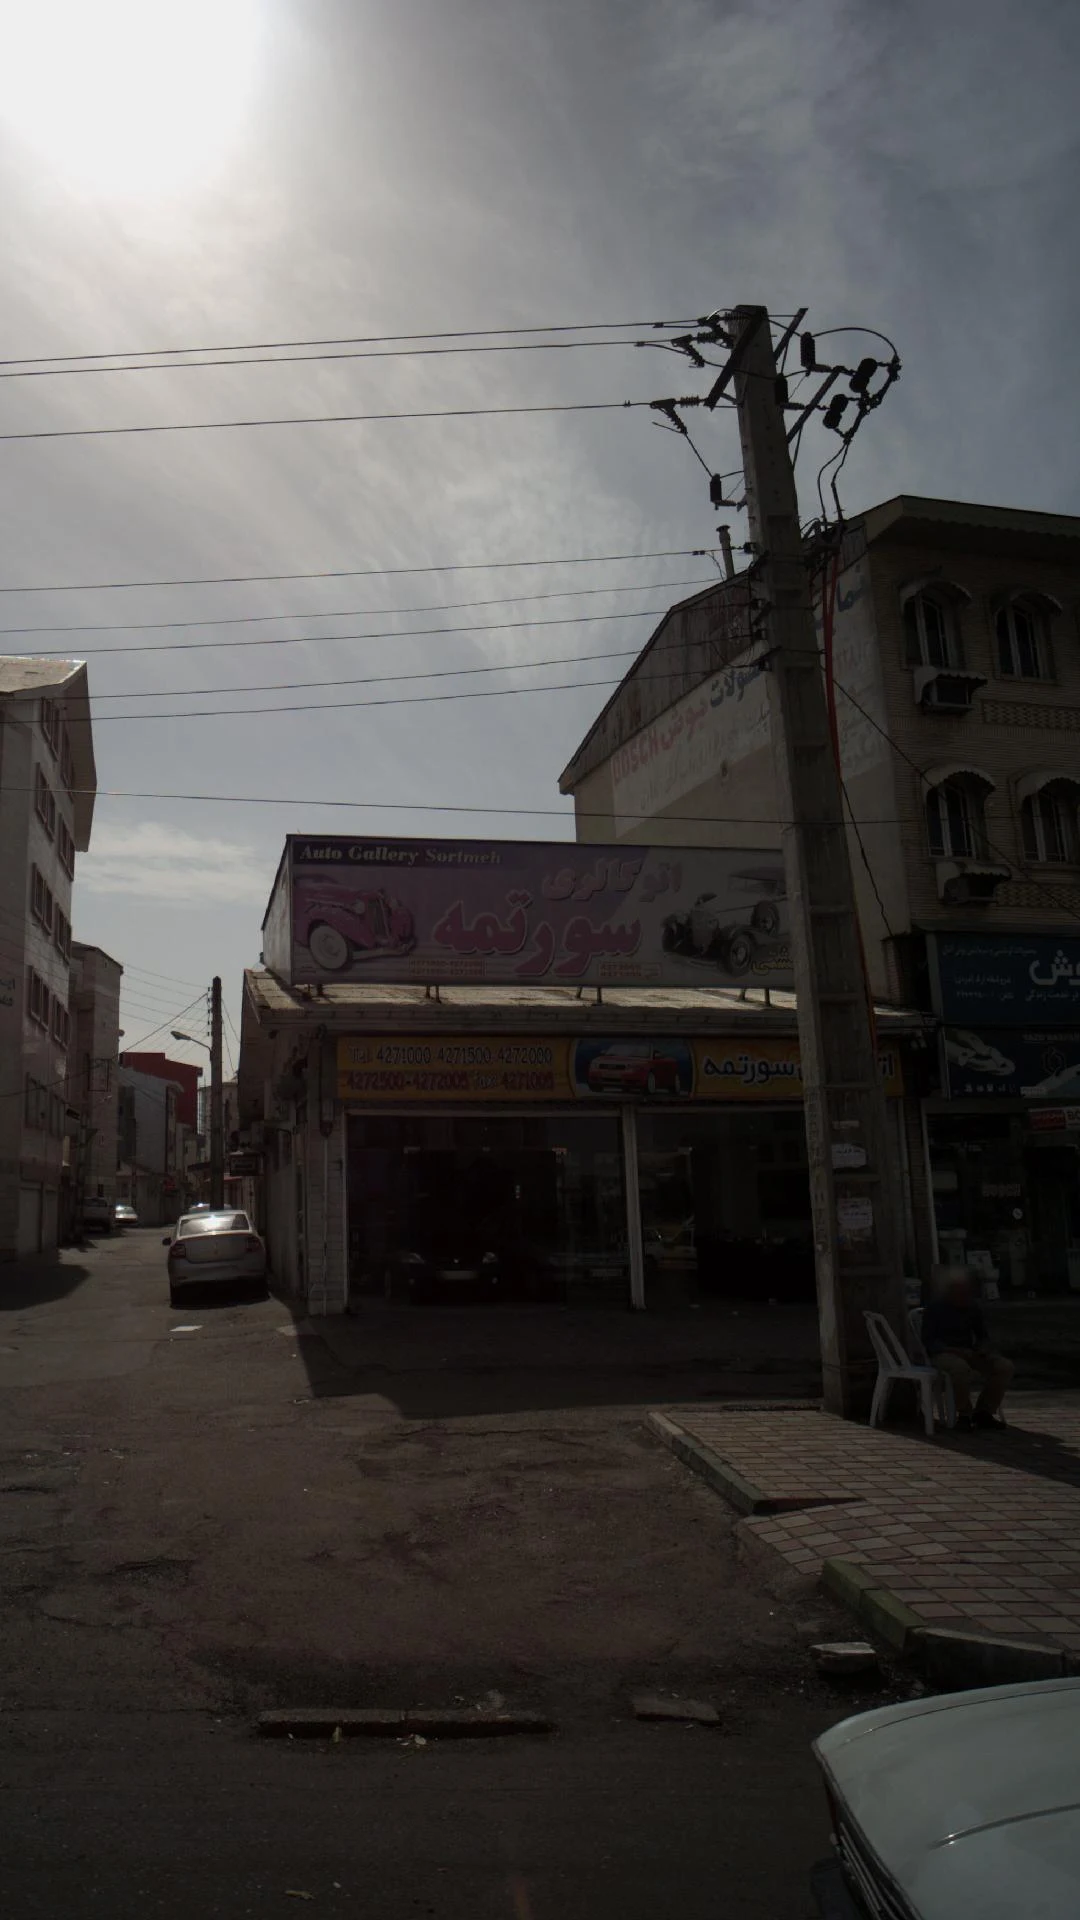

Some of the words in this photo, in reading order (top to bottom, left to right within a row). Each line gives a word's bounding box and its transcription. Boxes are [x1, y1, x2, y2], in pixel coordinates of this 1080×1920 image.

[301, 845, 342, 860] Auto
[348, 846, 419, 866] Gallery
[432, 889, 643, 977] سورتمه
[376, 1046, 432, 1065] 4271000
[705, 1055, 795, 1085] سورتمه
